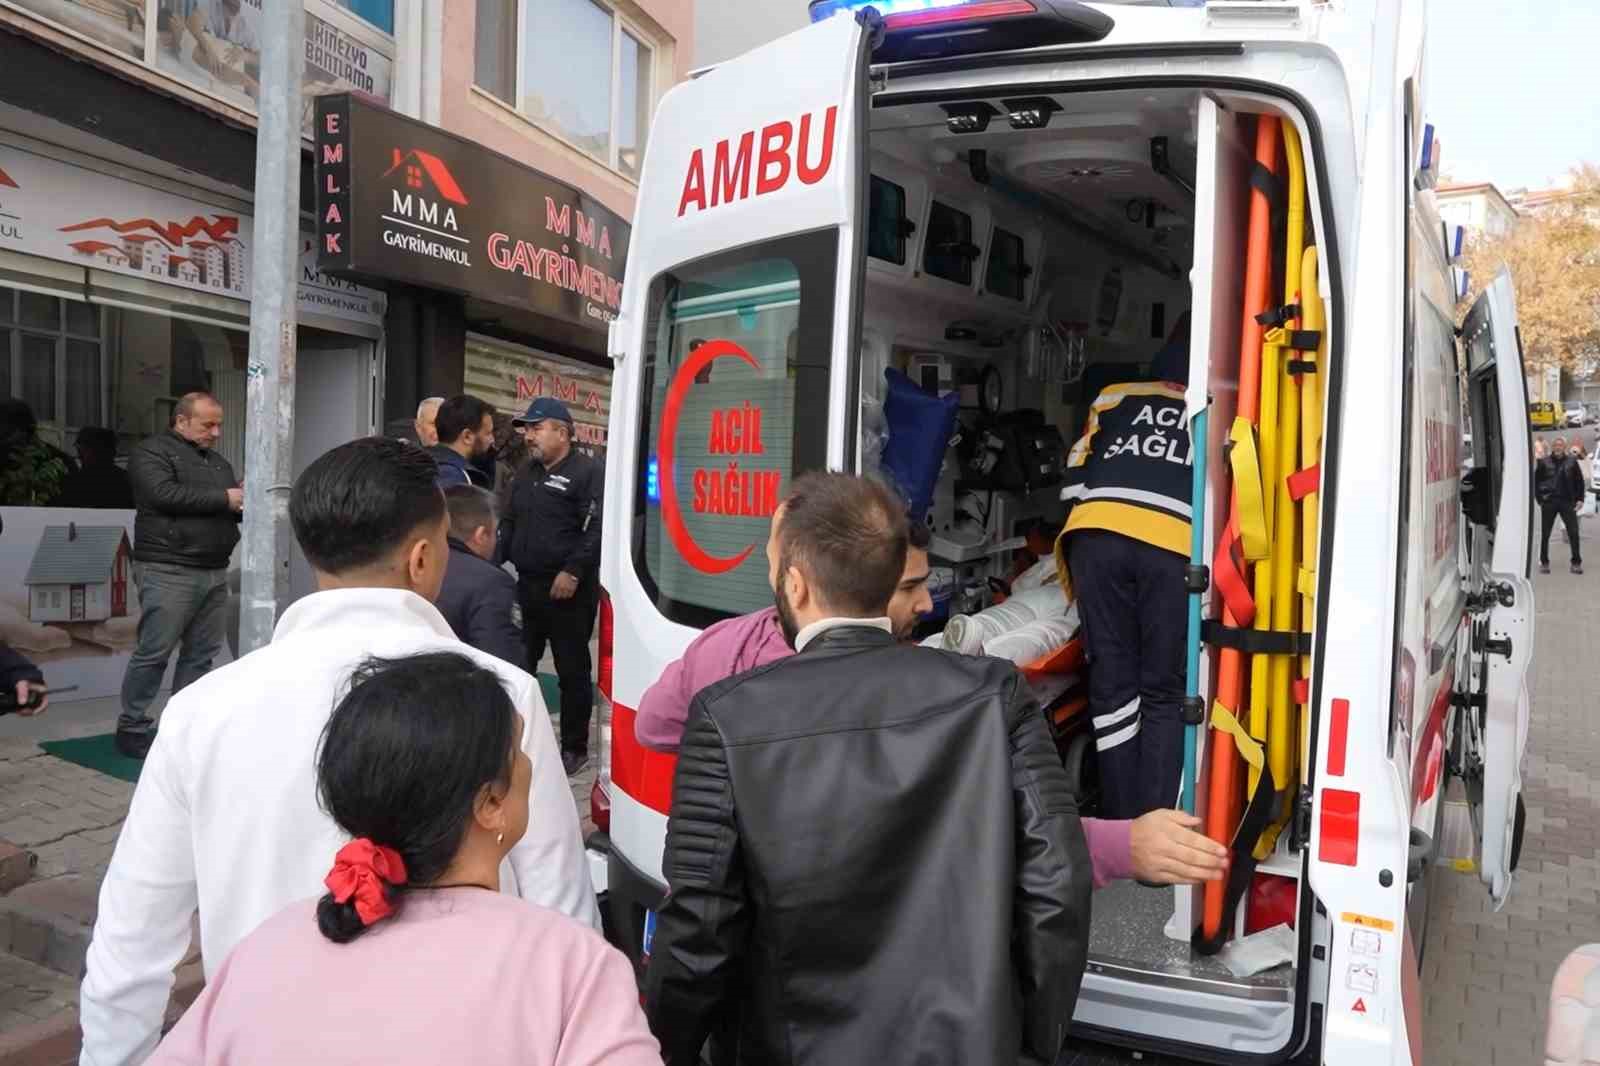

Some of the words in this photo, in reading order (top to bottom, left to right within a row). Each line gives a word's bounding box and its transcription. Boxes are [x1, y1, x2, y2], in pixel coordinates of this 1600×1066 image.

[305, 40, 374, 95] BANTLAMA
[322, 113, 343, 254] EMLAK
[677, 105, 838, 217] AMBU
[383, 230, 471, 267] GAYRİMENKUL
[709, 400, 766, 455] ACİL
[693, 461, 781, 517] SAĞLIK
